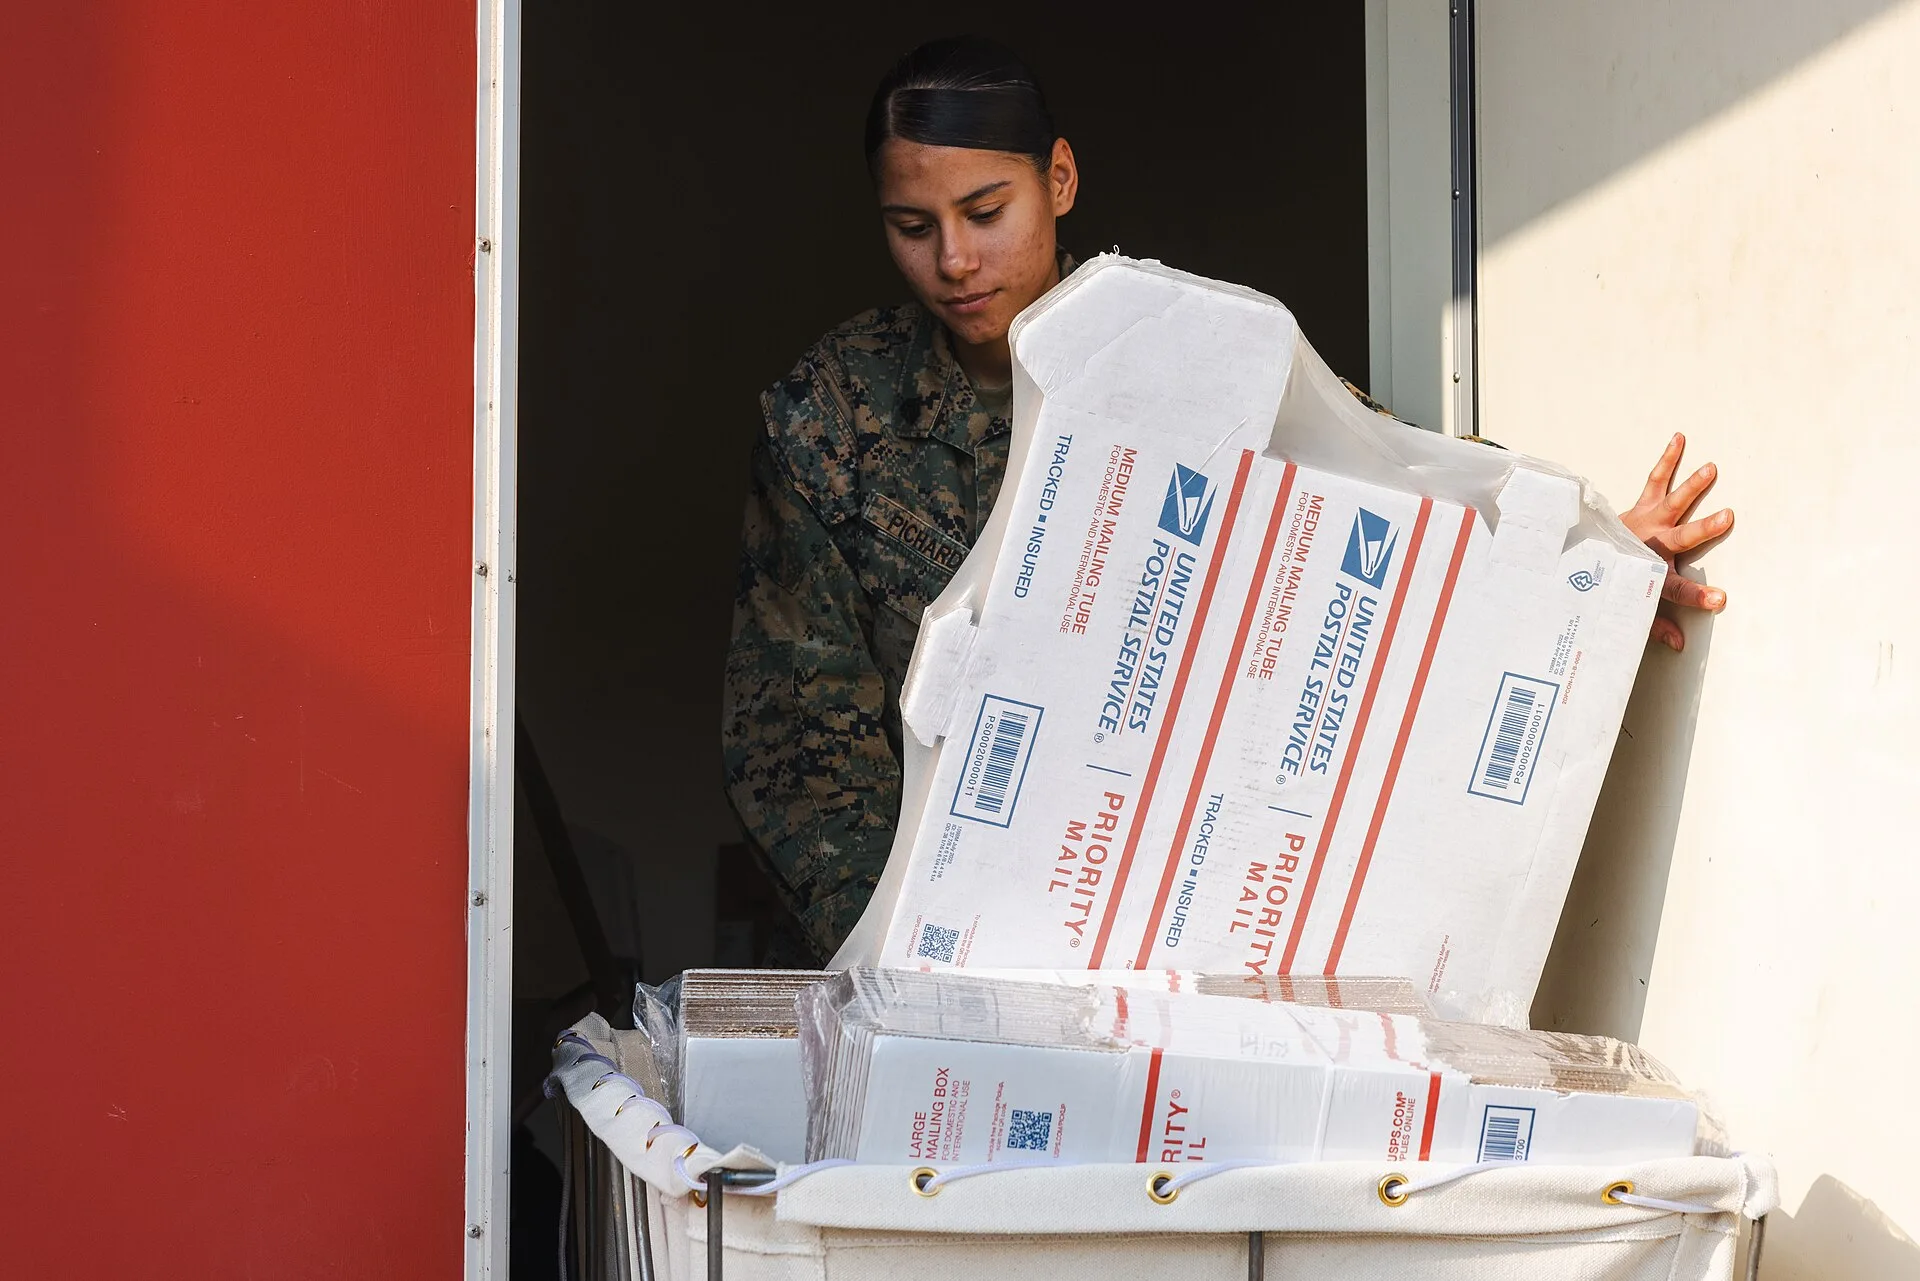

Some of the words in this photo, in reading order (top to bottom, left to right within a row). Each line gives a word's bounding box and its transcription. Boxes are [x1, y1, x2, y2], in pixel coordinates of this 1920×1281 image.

[1038, 433, 1072, 511] TRACKED
[1106, 447, 1137, 517] MEDIUM
[1107, 444, 1122, 466] FOR
[1093, 466, 1115, 517] DOMESTIC
[1295, 490, 1309, 512] FOR
[886, 514, 967, 571] PICHARD
[1013, 525, 1045, 599] INSURED
[1085, 519, 1116, 588] MAILING
[1086, 517, 1100, 539] AND
[1280, 512, 1302, 563] DOMESTIC
[1293, 494, 1324, 563] MEDIUM
[1064, 539, 1093, 613] INTERNATIONAL
[1127, 538, 1170, 630] POSTAL
[1153, 552, 1196, 647] UNITED
[1272, 565, 1304, 634] MAILING
[1274, 563, 1287, 585] AND
[1058, 613, 1072, 634] USE
[1071, 590, 1096, 635] TUBE
[1252, 585, 1281, 658] INTERNATIONAL
[1310, 581, 1352, 673] POSTAL
[1335, 595, 1377, 690] UNITED
[1246, 659, 1259, 680] USE
[1258, 636, 1283, 680] TUBE
[1553, 646, 1561, 657] July
[1127, 646, 1167, 734] STATES
[964, 714, 996, 797] PS00020000011
[1309, 688, 1349, 775] STATES
[1513, 702, 1545, 785] PS00020000011
[1048, 819, 1087, 894] MAIL
[1190, 792, 1224, 866] TRACKED
[1164, 879, 1196, 949] INSURED
[1229, 860, 1268, 935] MAIL
[934, 1067, 949, 1097] BOX
[950, 1080, 960, 1098] AND
[1403, 1098, 1416, 1132] ONLINE
[909, 1111, 926, 1158] LARGE
[925, 1101, 944, 1159] MAILING
[941, 1143, 950, 1161] FOR
[944, 1099, 957, 1142] DOMESTIC
[952, 1099, 967, 1160] INTERNATIONAL
[961, 1080, 970, 1097] USE
[1399, 1134, 1410, 1161] PLIES
